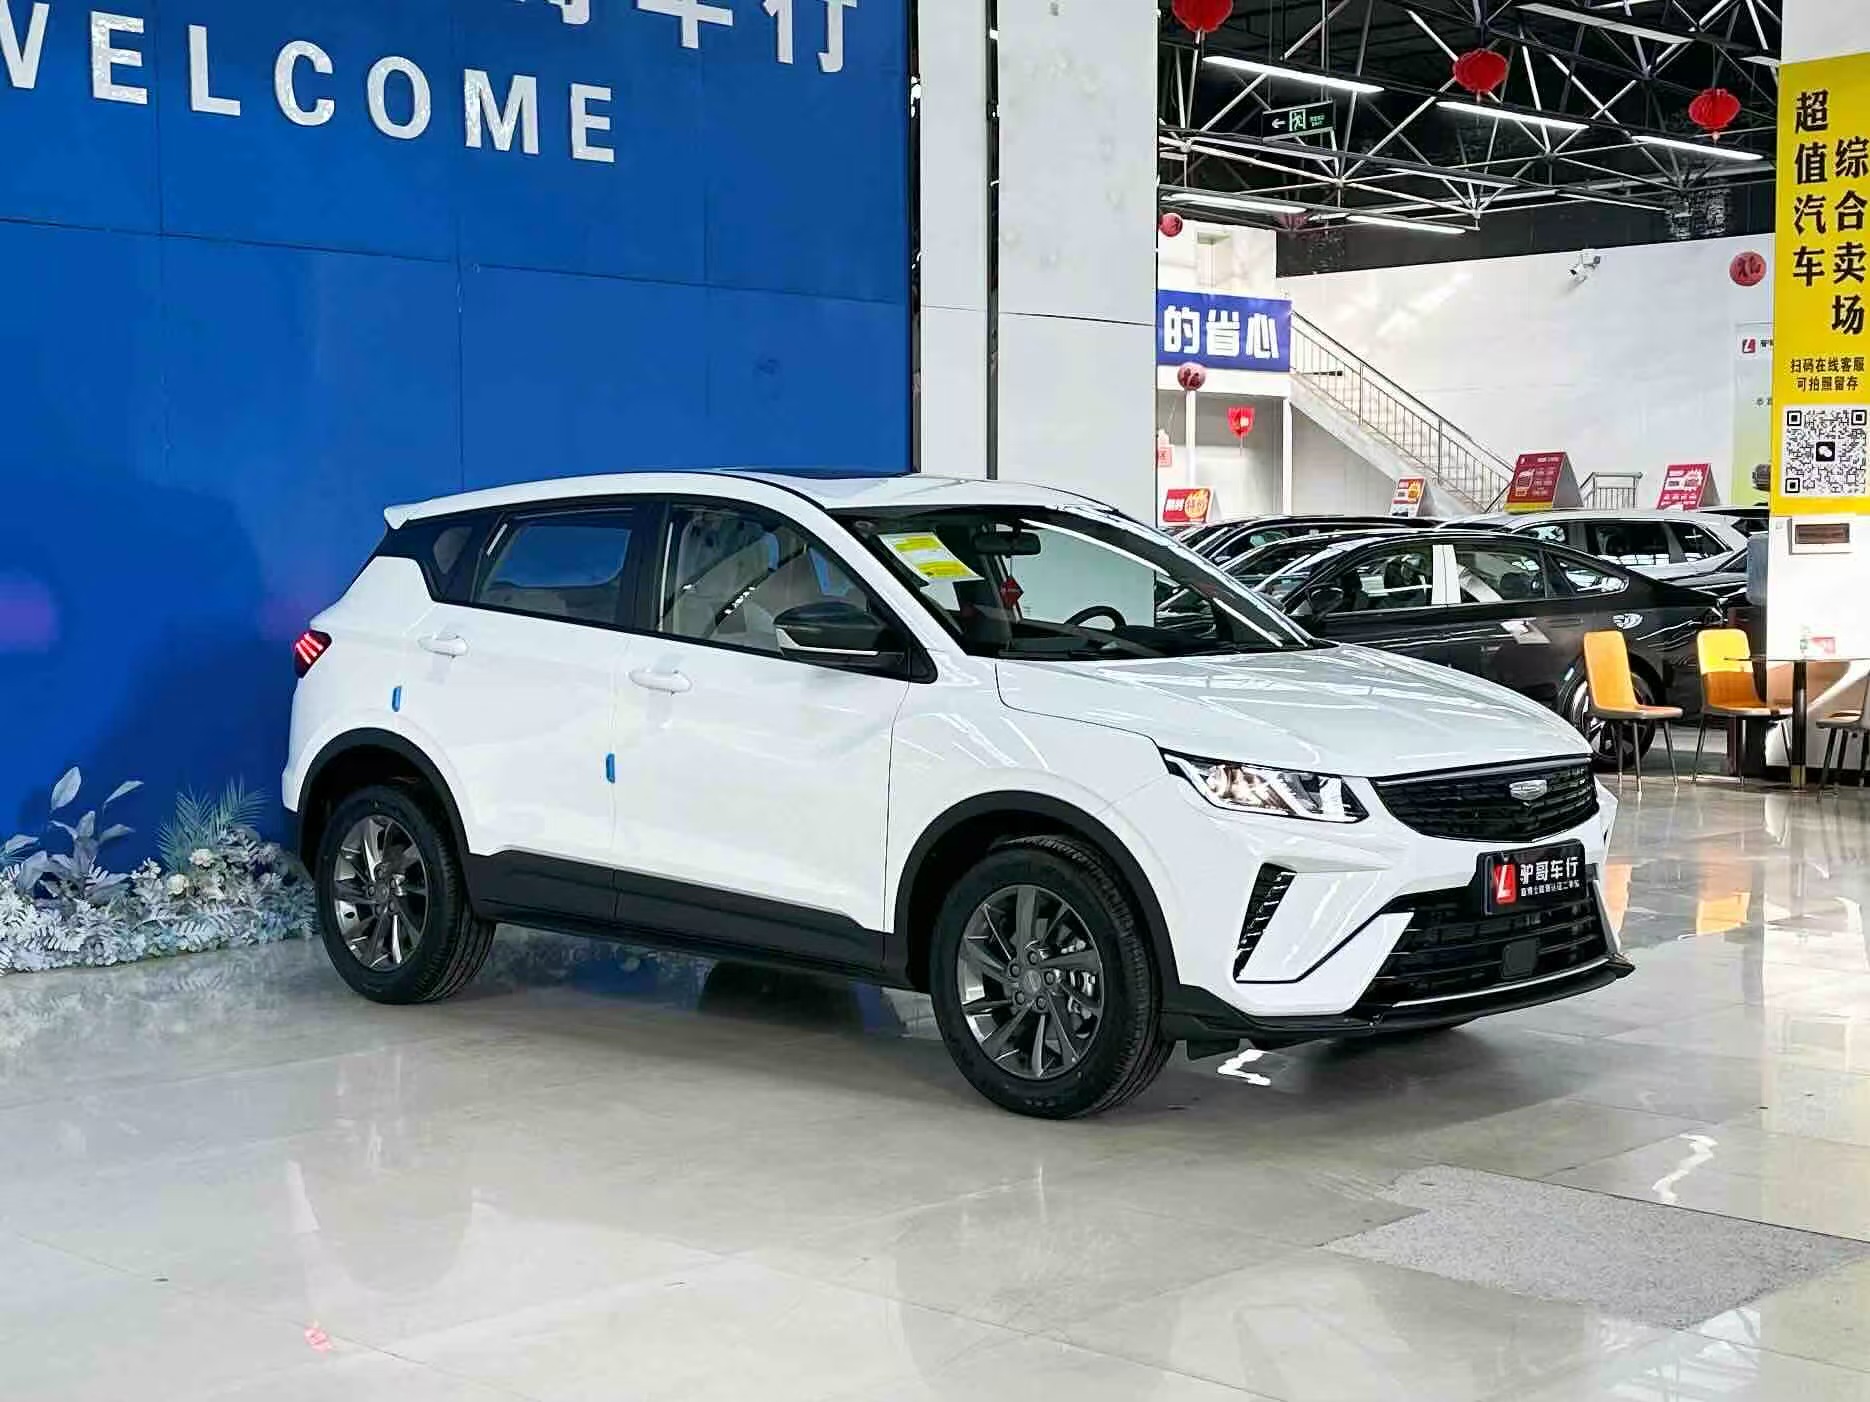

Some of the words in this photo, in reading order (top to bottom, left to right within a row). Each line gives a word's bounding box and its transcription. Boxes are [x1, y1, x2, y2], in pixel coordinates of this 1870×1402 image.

[1792, 89, 1829, 287] 超值汽车
[1831, 135, 1869, 335] 综合卖场
[1164, 305, 1280, 359] 的省心
[1520, 857, 1579, 885] 驴哥车行
